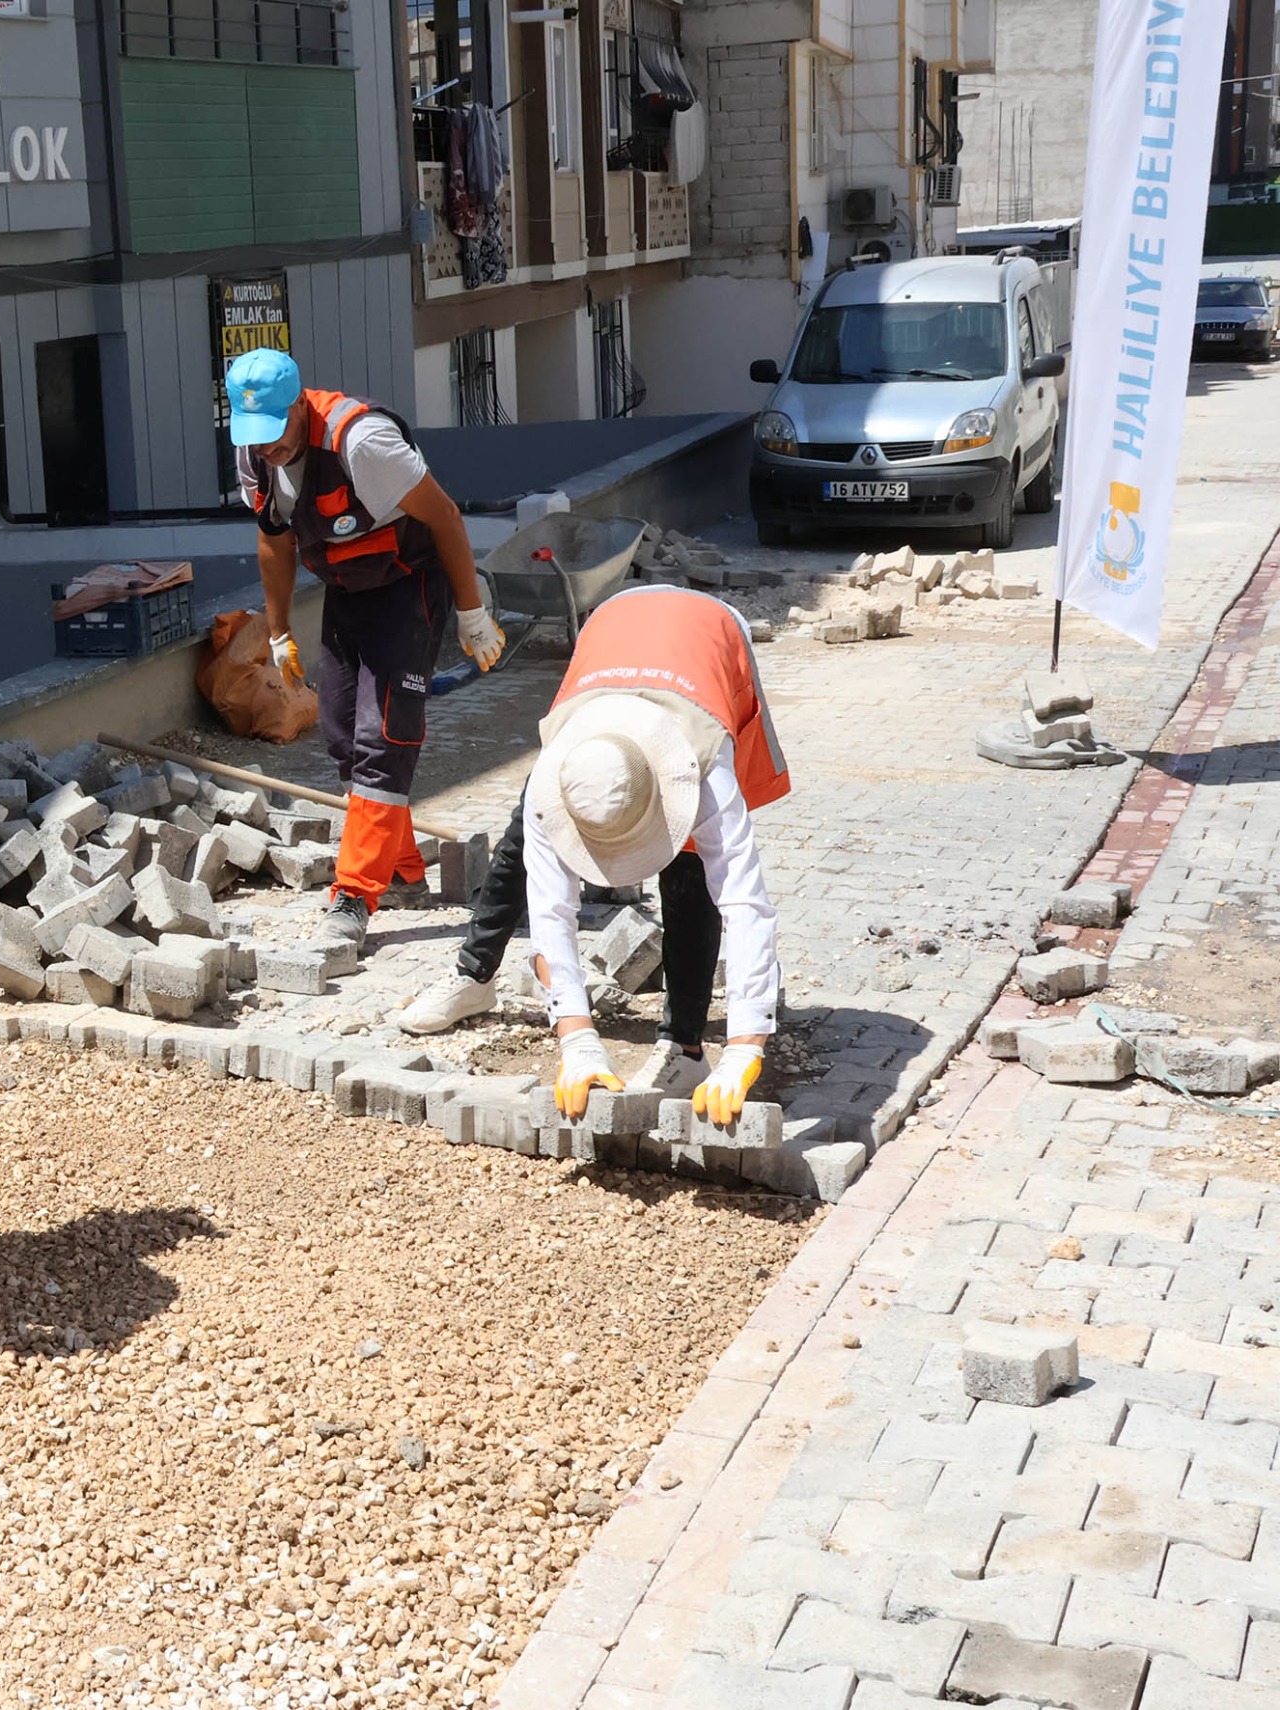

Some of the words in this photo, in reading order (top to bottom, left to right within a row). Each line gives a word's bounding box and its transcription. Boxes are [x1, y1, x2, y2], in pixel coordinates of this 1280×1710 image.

[233, 281, 272, 302] KURTOĞLU
[1113, 233, 1165, 460] HALİLİYE
[832, 483, 848, 496] 16
[851, 483, 877, 496] ATV
[880, 483, 906, 496] 752
